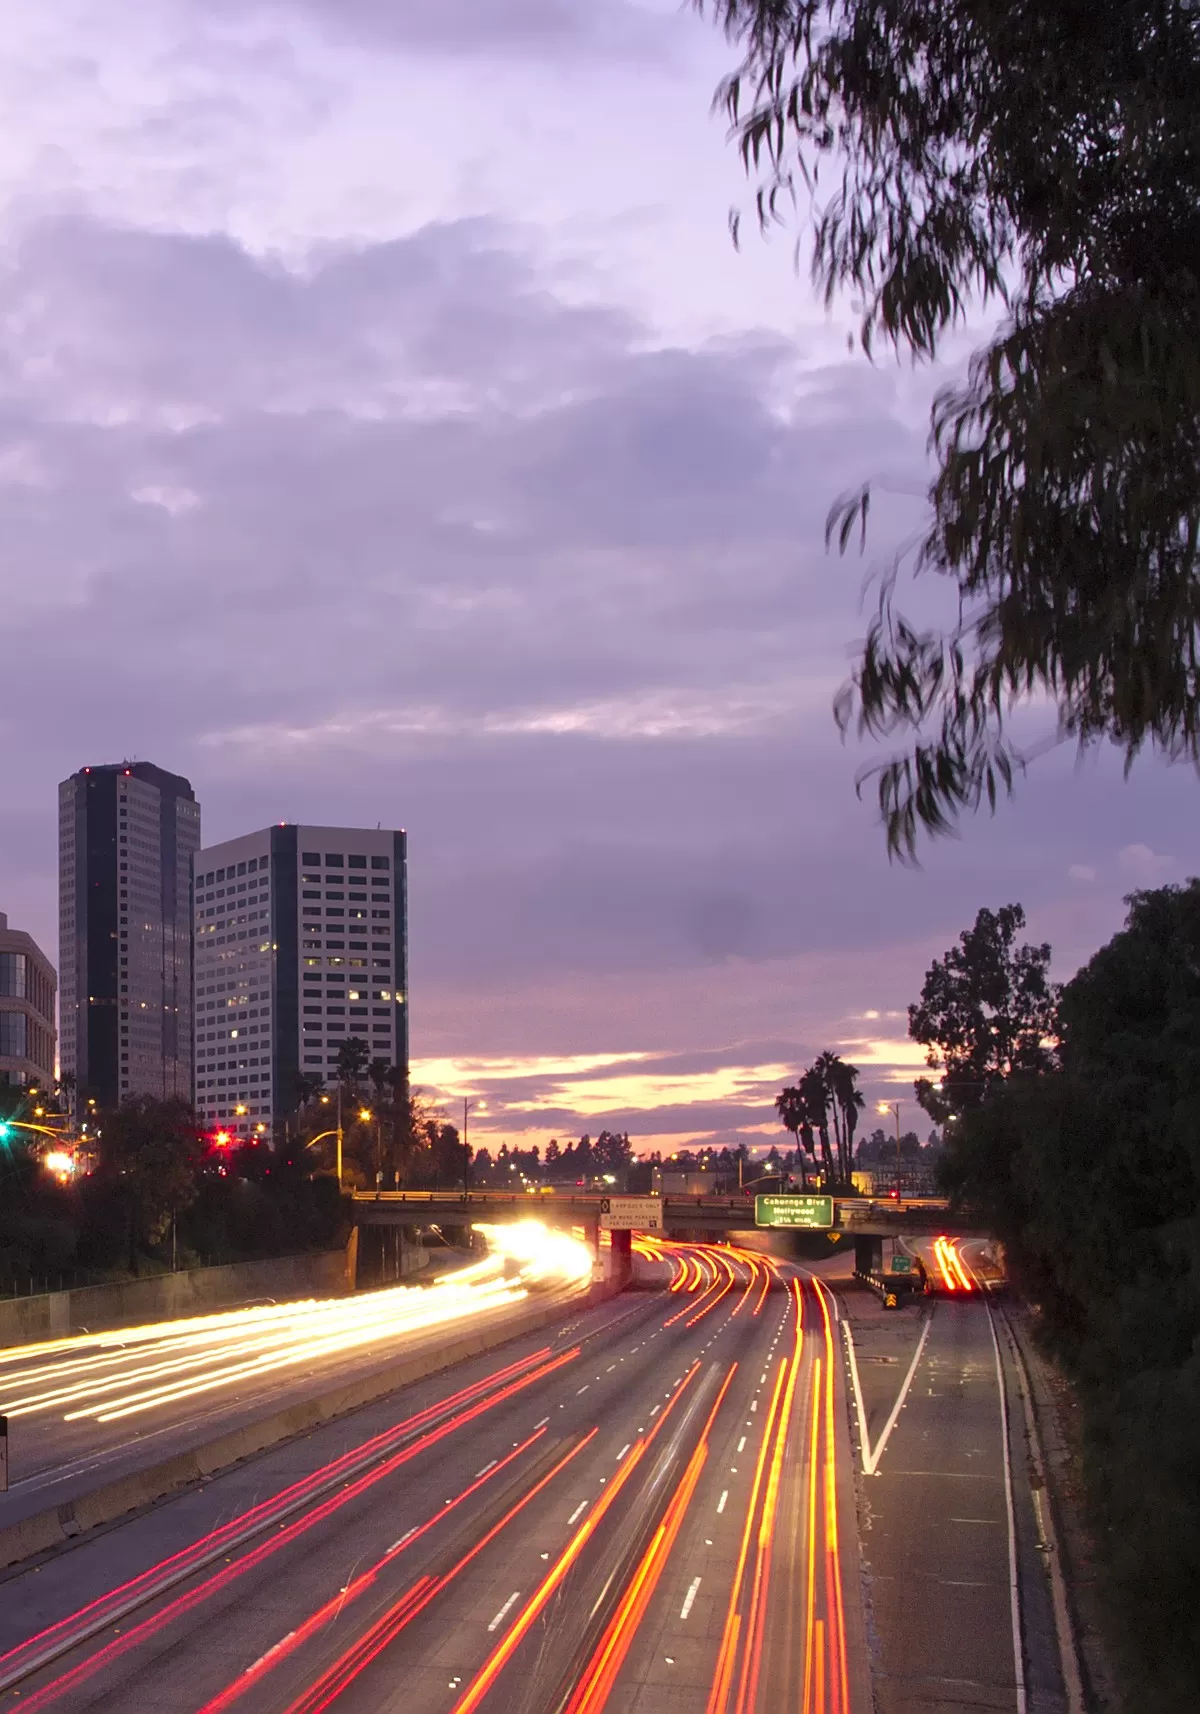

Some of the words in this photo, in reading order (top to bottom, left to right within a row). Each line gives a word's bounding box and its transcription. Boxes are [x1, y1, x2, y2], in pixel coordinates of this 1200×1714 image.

[763, 1198, 804, 1207] Cahuenga
[806, 1198, 826, 1206] Blvd
[773, 1207, 815, 1216] Hollywood
